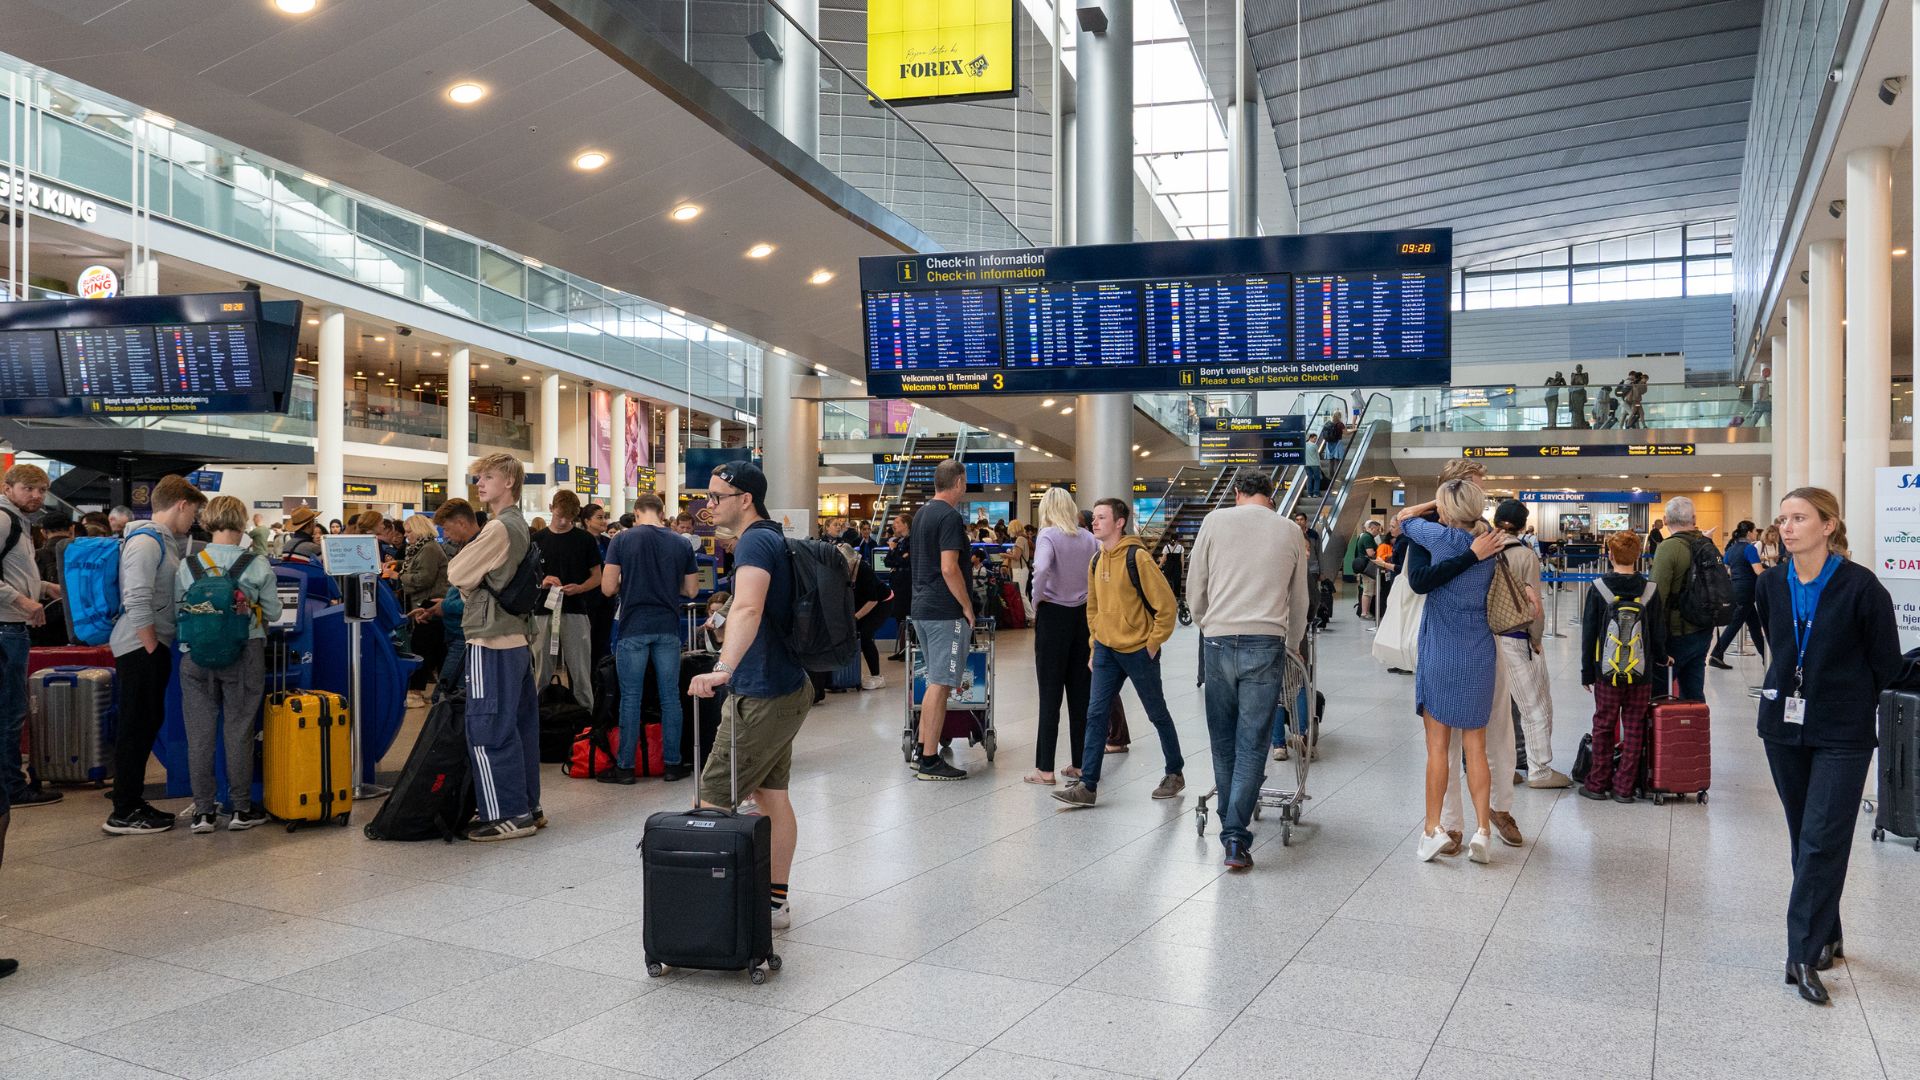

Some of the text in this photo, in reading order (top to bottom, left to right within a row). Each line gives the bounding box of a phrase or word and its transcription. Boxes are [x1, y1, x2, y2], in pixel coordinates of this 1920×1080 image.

[900, 59, 964, 79] FOREX
[43, 187, 97, 223] KING
[1401, 243, 1432, 253] 09:28
[926, 252, 1045, 269] Check-in information
[83, 273, 111, 286] BURGER
[927, 266, 1046, 283] Check-in information
[84, 280, 111, 296] KING
[1200, 362, 1359, 377] Benyt venligst Check-in Selvbetjening
[901, 373, 1004, 390] Velkommen til Terminal 3
[1200, 377, 1228, 385] Please
[1248, 375, 1264, 384] Self
[1267, 375, 1299, 383] Service
[1301, 373, 1339, 382] Check-in
[901, 382, 980, 392] Welcome to Terminal
[104, 397, 120, 405] Benyt
[121, 396, 143, 405] venligst
[171, 396, 209, 404] Selvbetjening
[105, 404, 124, 412] Please
[1231, 417, 1252, 425] Afgang
[1648, 445, 1656, 455] 2
[1540, 493, 1565, 501] SERVICE
[1565, 493, 1585, 501] POINT
[1903, 603, 1916, 612] du
[951, 641, 959, 655] WEST
